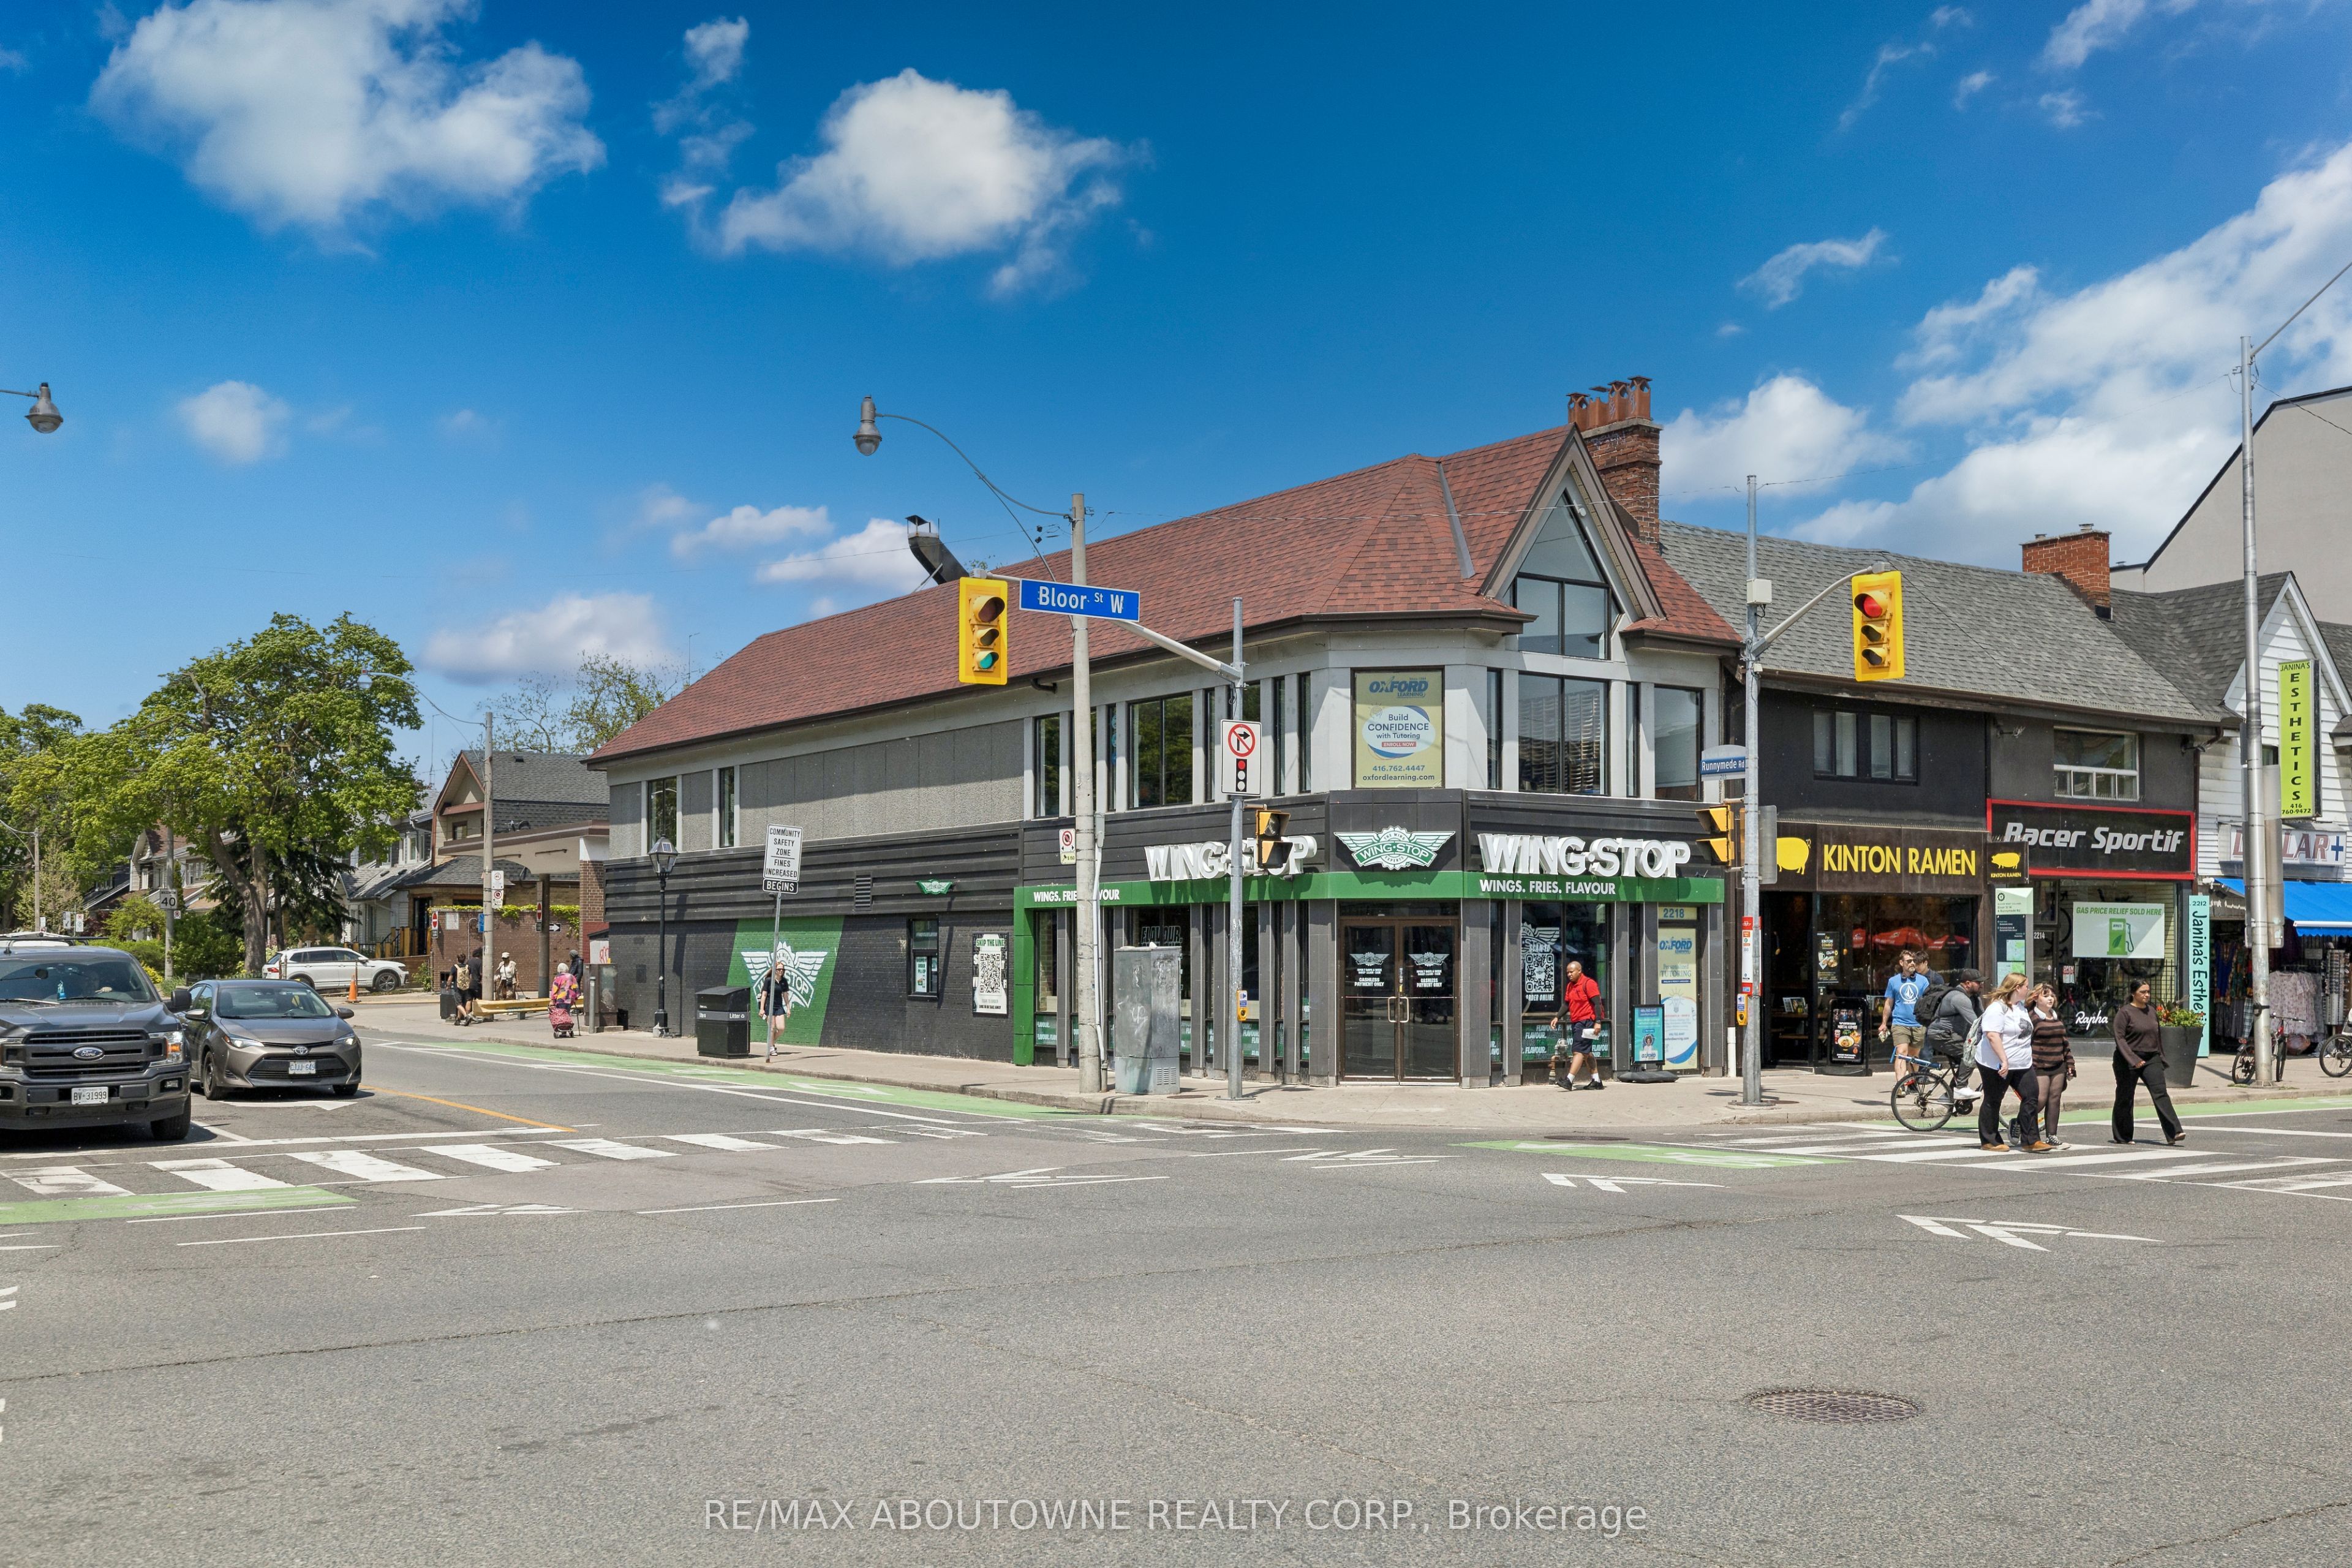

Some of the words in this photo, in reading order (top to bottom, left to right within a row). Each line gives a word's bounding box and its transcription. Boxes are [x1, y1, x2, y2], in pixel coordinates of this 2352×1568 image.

[1039, 586, 1087, 609] Bloor
[1095, 592, 1103, 603] St
[1110, 594, 1124, 613] W
[2280, 662, 2310, 671] JANINA'S
[1369, 678, 1429, 693] OXFORD
[2290, 673, 2301, 801] ESTHETICS
[1702, 760, 1737, 772] Runnymede
[769, 827, 801, 838] COMMUNITY
[2004, 823, 2086, 847] Racer
[2091, 827, 2184, 854] Sportif
[774, 838, 794, 846] SAFETY
[1823, 845, 1901, 873] KINTON
[1908, 848, 1975, 875] RAMEN
[766, 868, 797, 878] INCREASED
[767, 881, 794, 892] BEGINS
[1480, 880, 1525, 892] WINGS.
[1529, 881, 1561, 894] FRIES.
[1566, 882, 1616, 895] FLAVOUR
[161, 897, 176, 906] 40
[1034, 891, 1061, 902] WINGS.
[1063, 890, 1077, 901] FRIE
[1663, 908, 1684, 918] 2218
[2192, 911, 2207, 965] Janina's
[1659, 940, 1692, 950] OXFORD
[2075, 1009, 2108, 1030] Rapha
